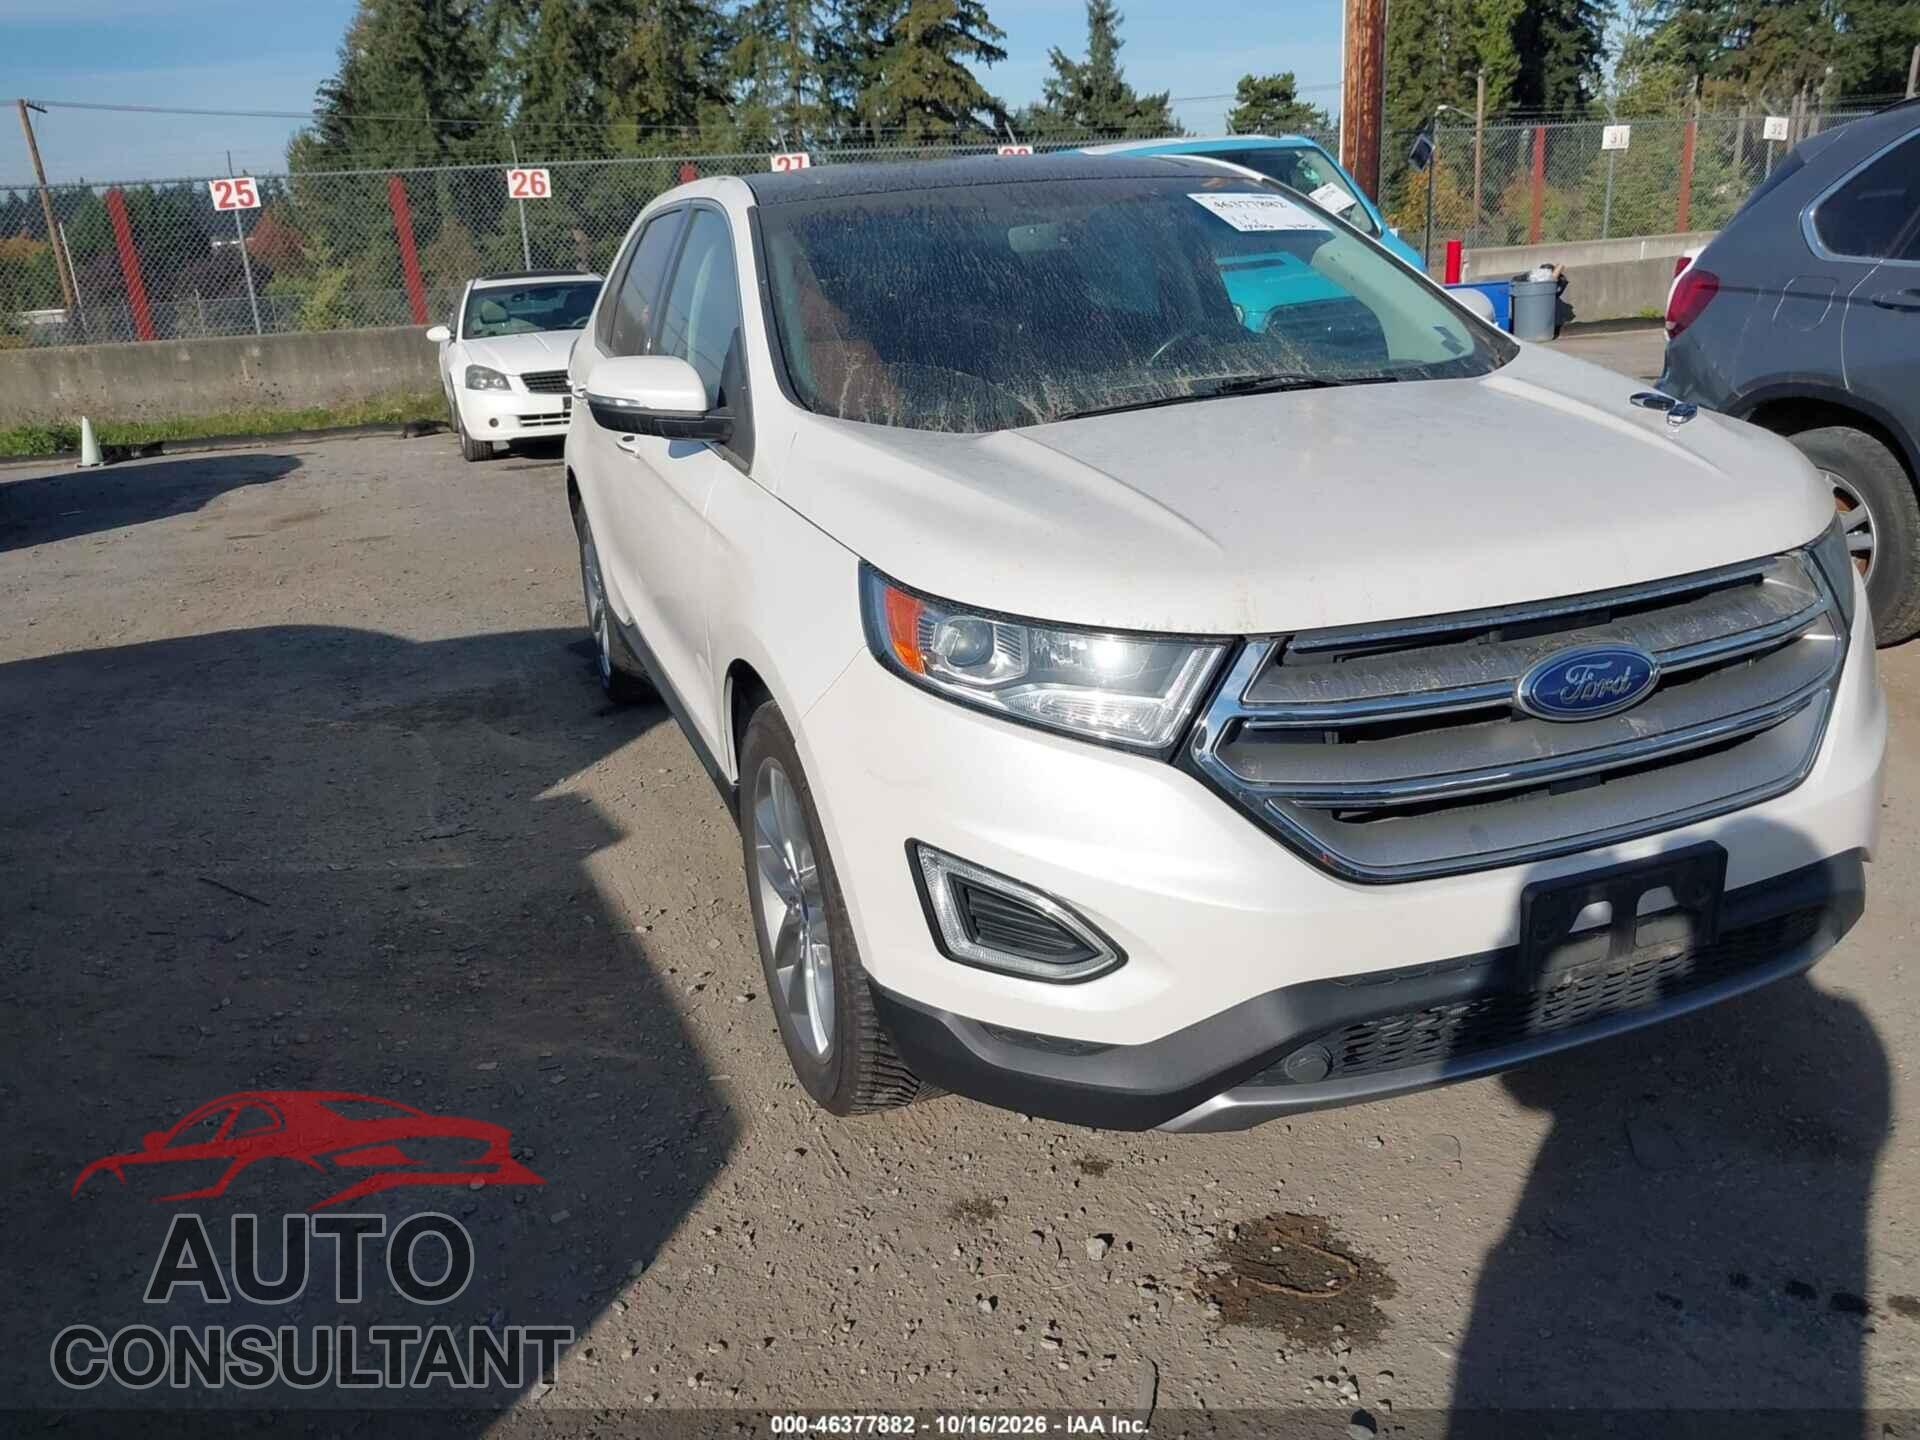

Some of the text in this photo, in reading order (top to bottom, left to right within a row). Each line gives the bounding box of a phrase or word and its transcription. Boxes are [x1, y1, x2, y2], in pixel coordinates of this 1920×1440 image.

[1609, 131, 1624, 144] 31
[214, 179, 255, 209] 25
[512, 171, 546, 197] 26
[1559, 660, 1633, 704] Ford
